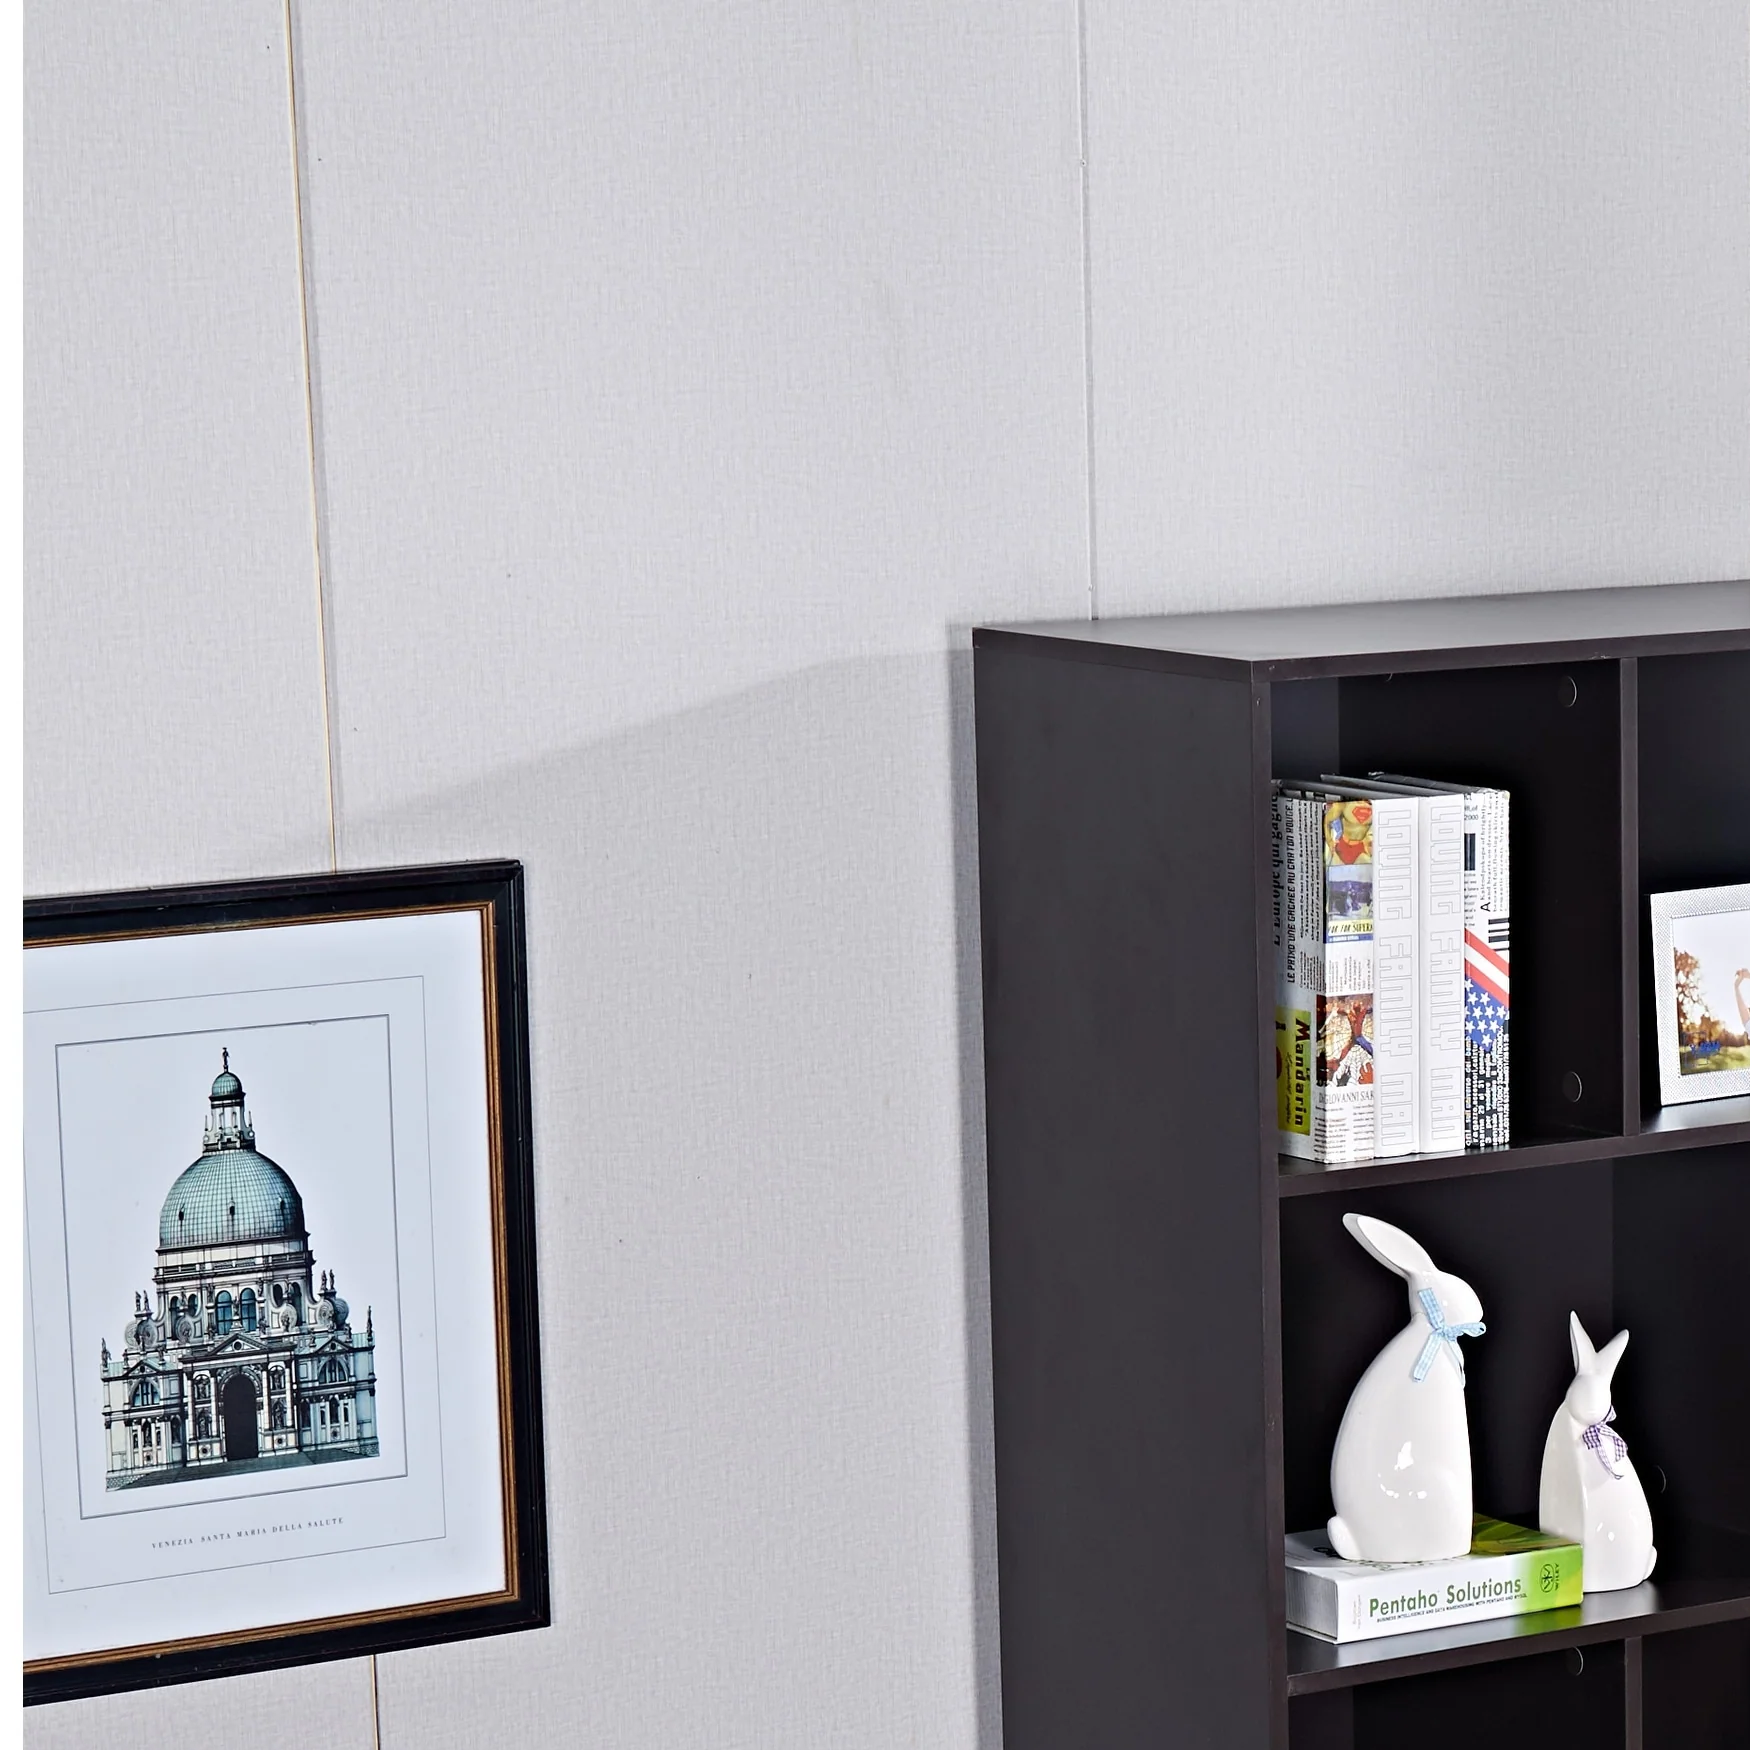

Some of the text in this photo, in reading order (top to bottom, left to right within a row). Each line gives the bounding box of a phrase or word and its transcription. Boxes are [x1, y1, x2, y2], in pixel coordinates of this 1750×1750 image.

[1294, 1018, 1311, 1126] Mandarin
[151, 1517, 344, 1549] VENEZIA SANTA MARIA DELLA SALUTE
[1369, 1589, 1438, 1617] Pentaho
[1446, 1578, 1522, 1604] Solutions
